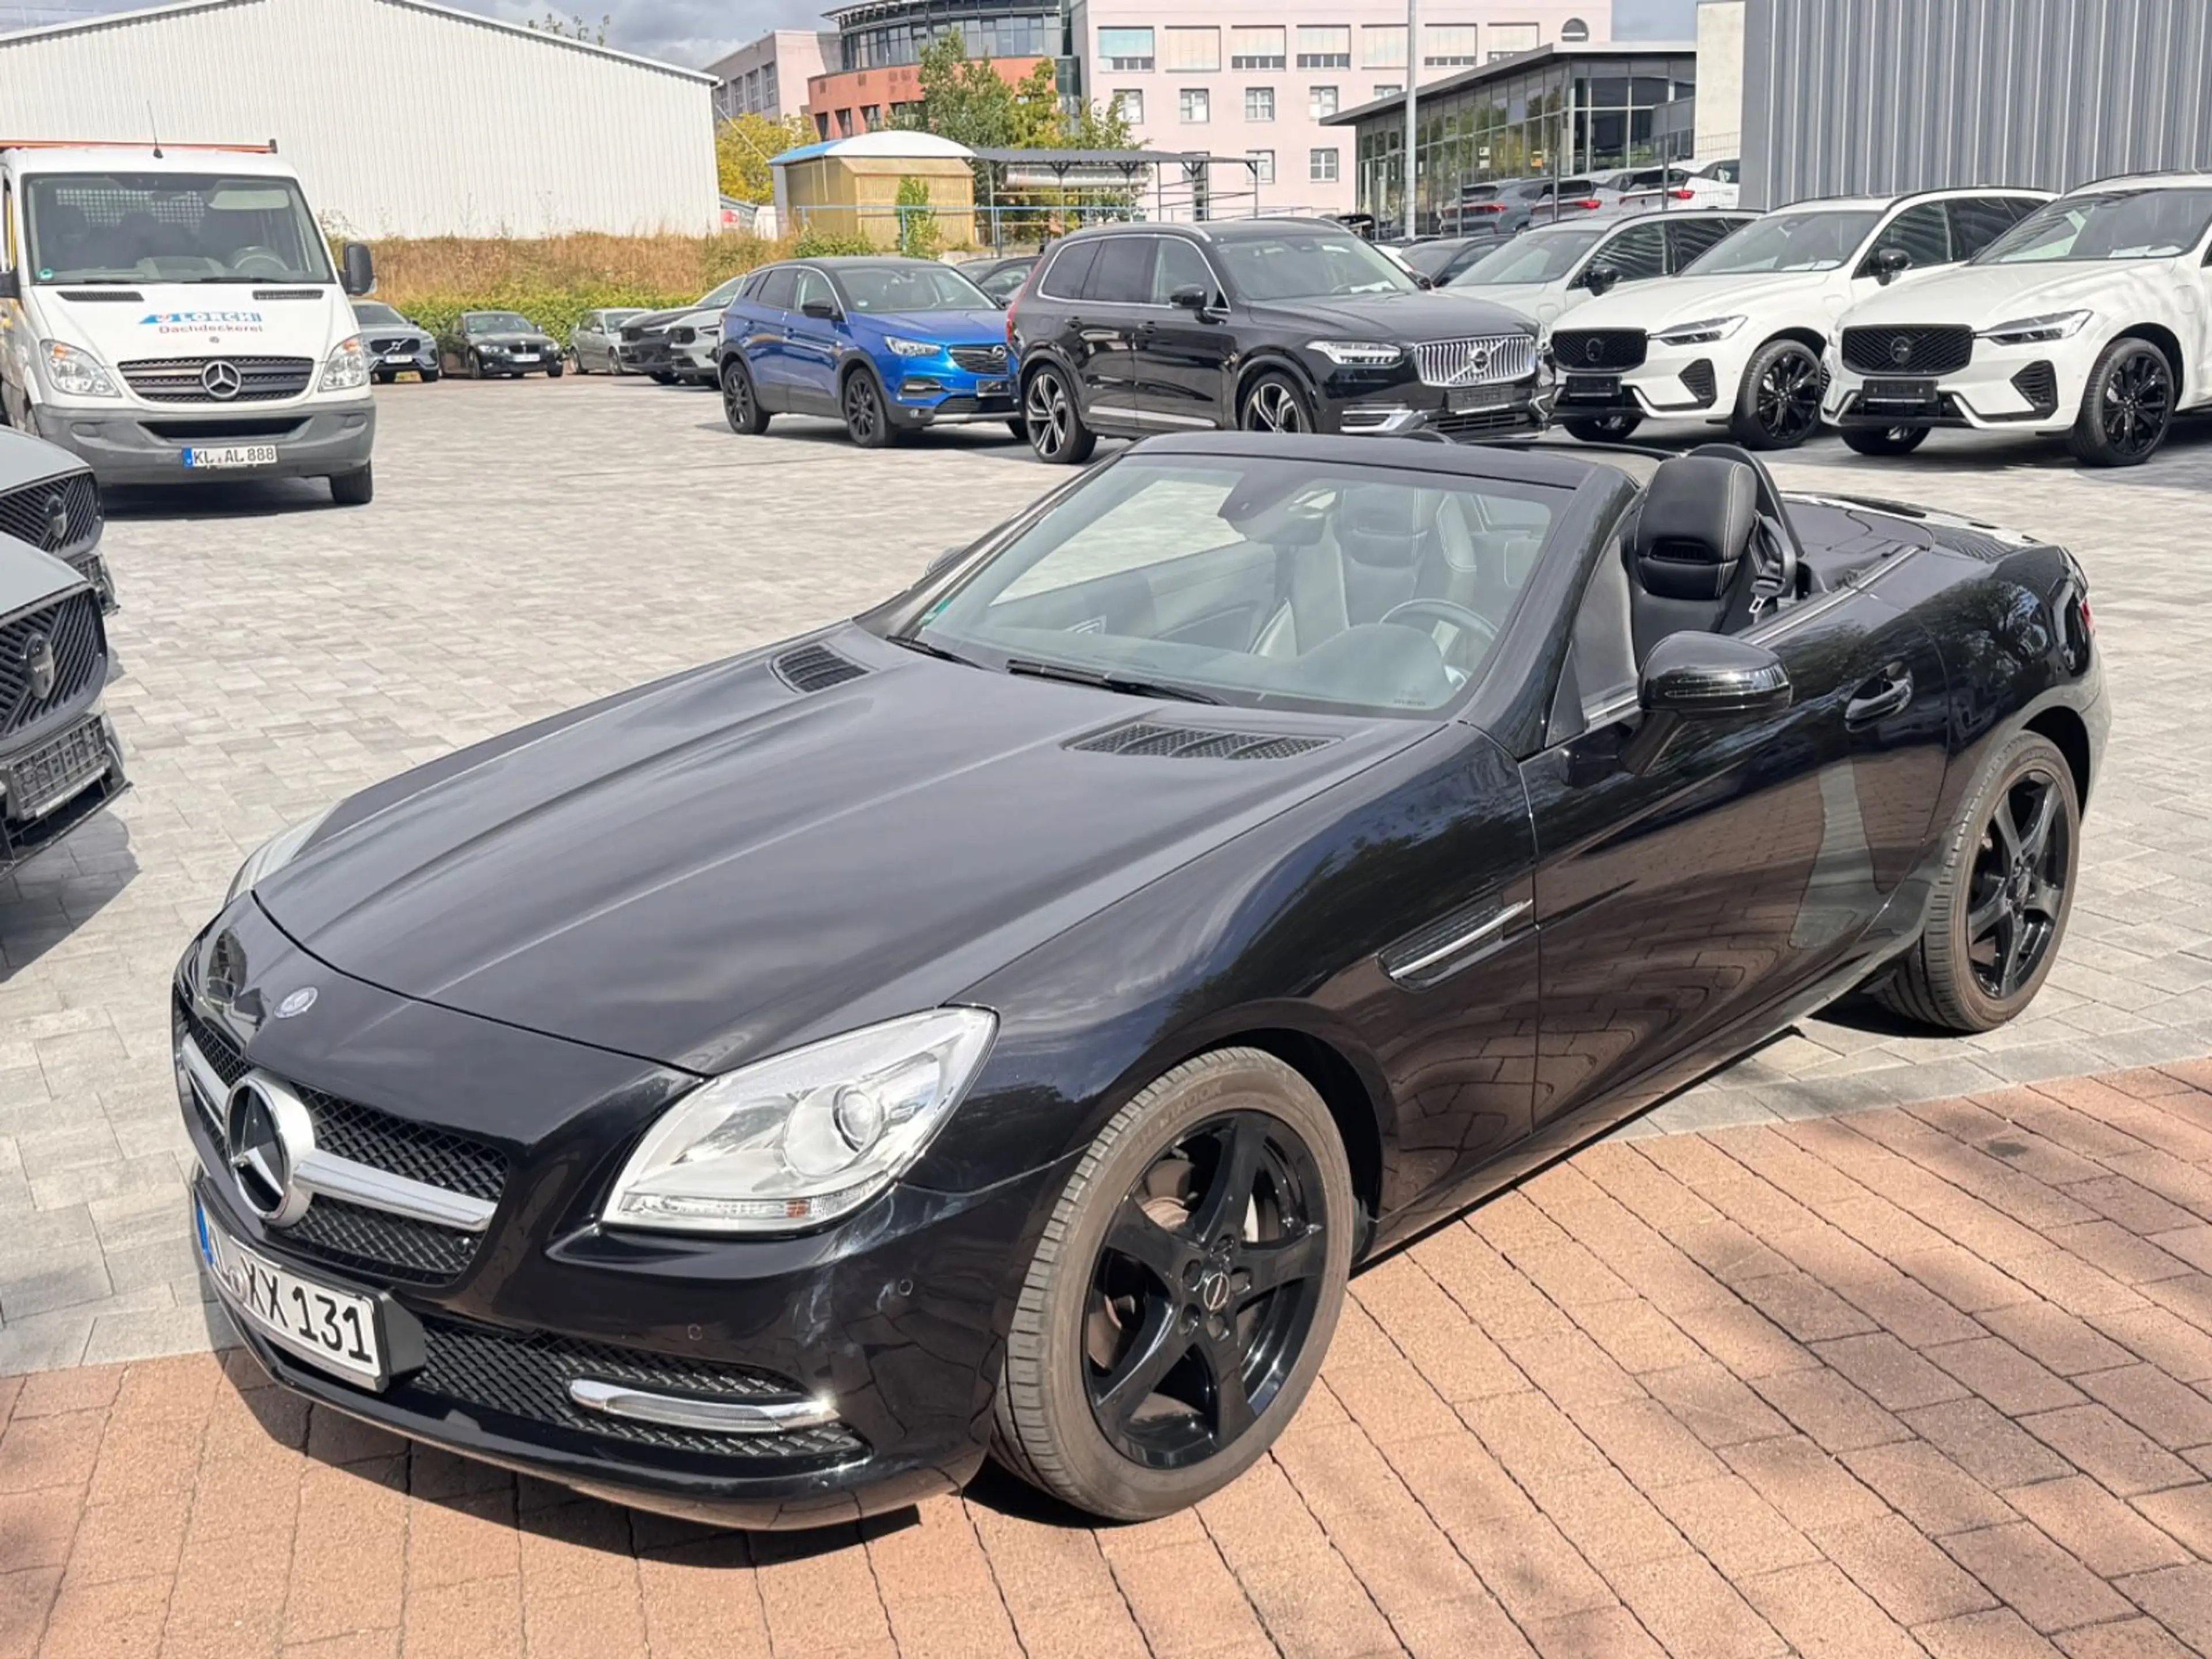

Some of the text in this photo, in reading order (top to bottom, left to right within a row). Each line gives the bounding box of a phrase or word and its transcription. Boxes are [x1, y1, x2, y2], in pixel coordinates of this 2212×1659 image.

[179, 312, 252, 322] LORCH
[158, 324, 263, 334] Dachdeckerei
[194, 447, 274, 464] KL AL 888
[240, 1253, 289, 1328] XX
[292, 1286, 373, 1364] 131
